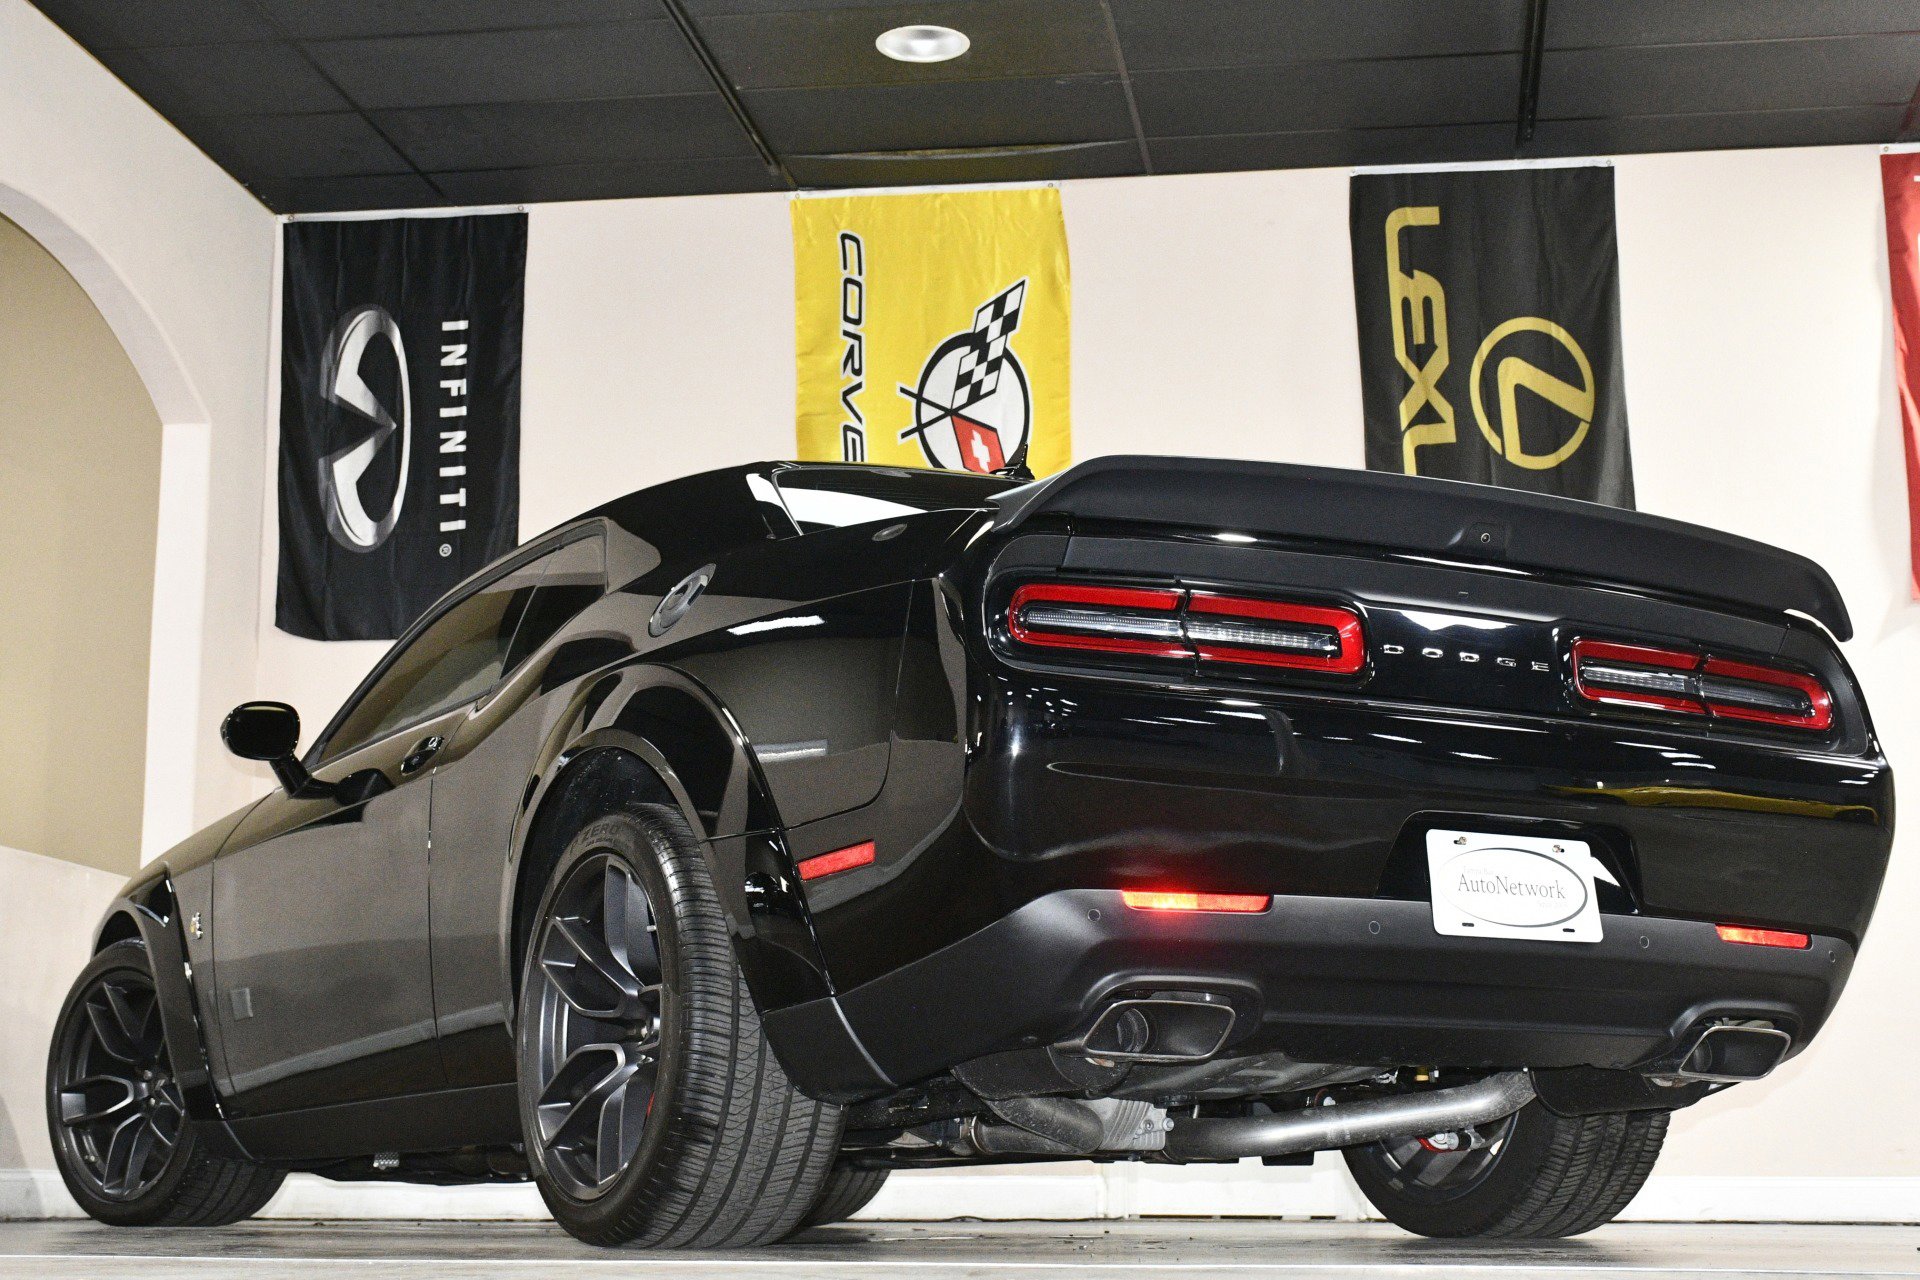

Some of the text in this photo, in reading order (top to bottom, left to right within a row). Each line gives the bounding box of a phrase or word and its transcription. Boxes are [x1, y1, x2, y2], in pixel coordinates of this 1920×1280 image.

[839, 231, 866, 462] CORVE
[439, 320, 469, 532] INFINITI
[1382, 643, 1550, 672] DODGE
[1458, 872, 1567, 899] AutoNetwork
